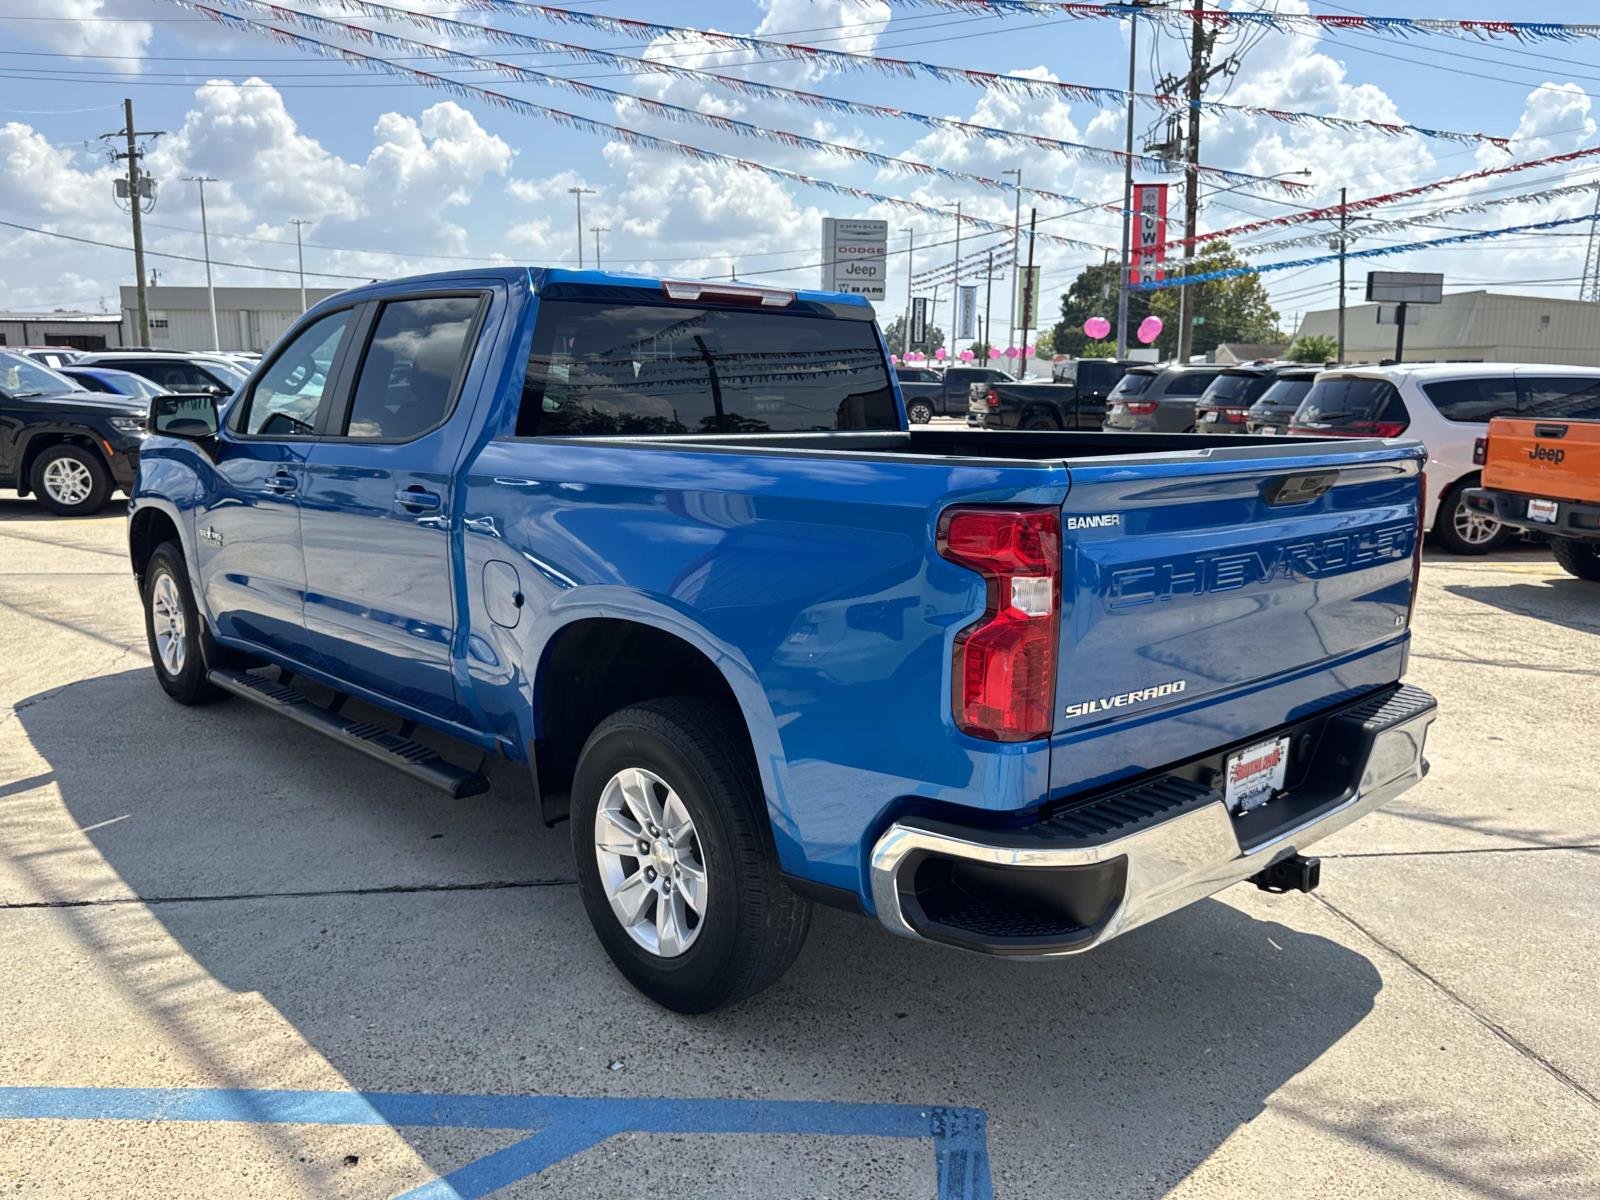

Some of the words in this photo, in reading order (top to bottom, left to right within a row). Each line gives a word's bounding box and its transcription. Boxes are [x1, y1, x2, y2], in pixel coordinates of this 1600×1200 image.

[838, 246, 885, 256] DODGE
[846, 263, 877, 277] Jeep
[851, 286, 883, 294] RAM
[1529, 443, 1565, 465] Jeep
[1067, 514, 1120, 530] BANNER
[1110, 523, 1414, 610] CHEVROLET
[1065, 680, 1187, 719] SILVERADO
